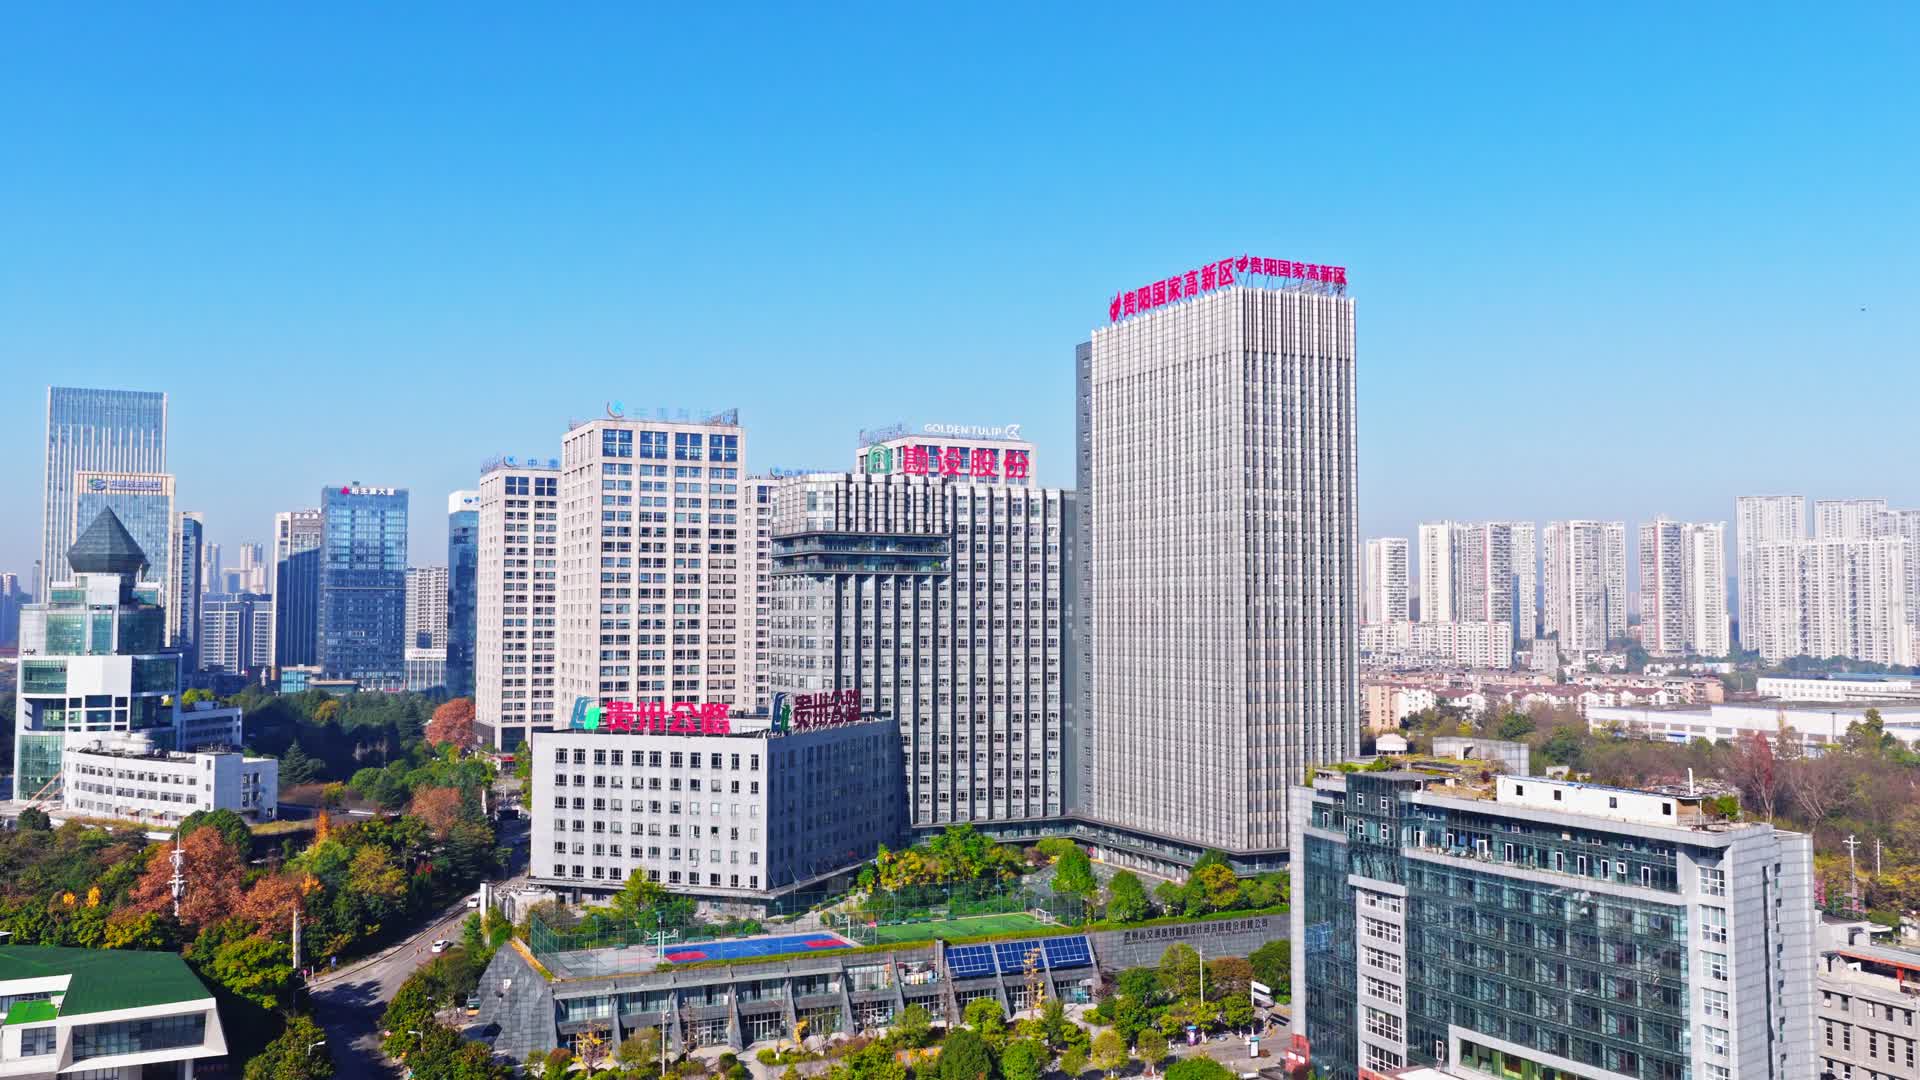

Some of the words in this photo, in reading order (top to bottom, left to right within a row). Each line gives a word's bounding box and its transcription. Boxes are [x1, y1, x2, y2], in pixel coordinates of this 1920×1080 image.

[1123, 257, 1235, 316] 贵阳国家高新区
[1250, 256, 1347, 285] 贵阳国家高新区
[924, 423, 969, 435] GOLDEN
[971, 427, 1002, 436] TULIP
[902, 444, 1029, 479] 勘设股份
[605, 700, 731, 734] 贵州公路
